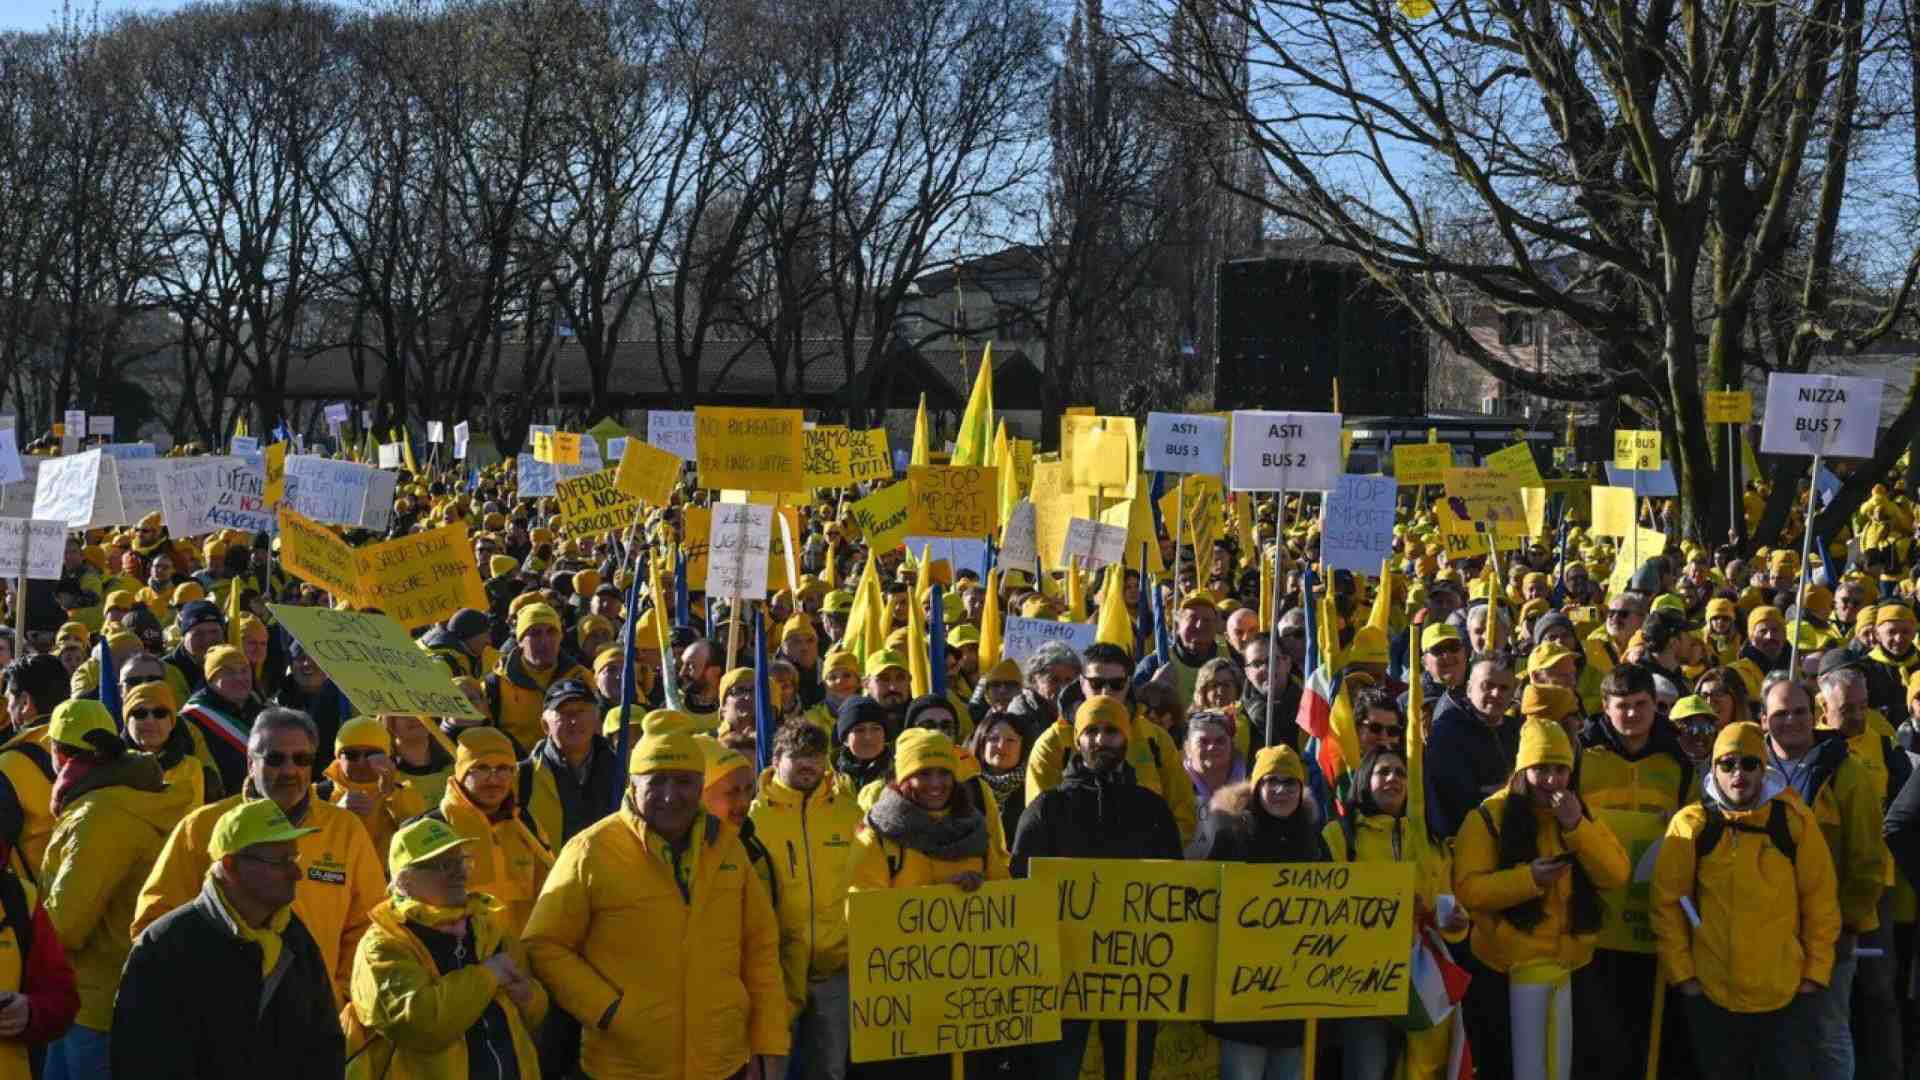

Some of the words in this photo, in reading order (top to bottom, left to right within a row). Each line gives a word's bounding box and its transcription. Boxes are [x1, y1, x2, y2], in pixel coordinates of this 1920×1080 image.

[1798, 388, 1846, 402] NIZZA
[1171, 423, 1199, 435] ASTI
[1268, 424, 1303, 438] ASTI
[1795, 417, 1828, 432] BUS
[1832, 418, 1842, 432] 7
[1166, 444, 1189, 456] BUS
[1192, 446, 1200, 456] 3
[1636, 437, 1656, 449] BUS
[1262, 454, 1292, 467] BUS
[1297, 454, 1307, 467] 2
[928, 469, 980, 490] STOP
[567, 499, 587, 516] LA
[1007, 618, 1075, 640] LOTTIAMO
[1273, 868, 1349, 890] SIAMO
[1123, 881, 1220, 923] RICERC
[1238, 892, 1401, 929] COLTIVATORI
[897, 895, 1016, 933] GIOVANI
[1092, 929, 1174, 968] MENO
[1292, 933, 1348, 957] FIN
[1306, 960, 1408, 995] ORIGINE
[1061, 972, 1189, 1013] AFFARI
[852, 994, 912, 1029] NON
[944, 985, 1059, 1020] SPEGNETECI
[891, 1028, 917, 1057] IL
